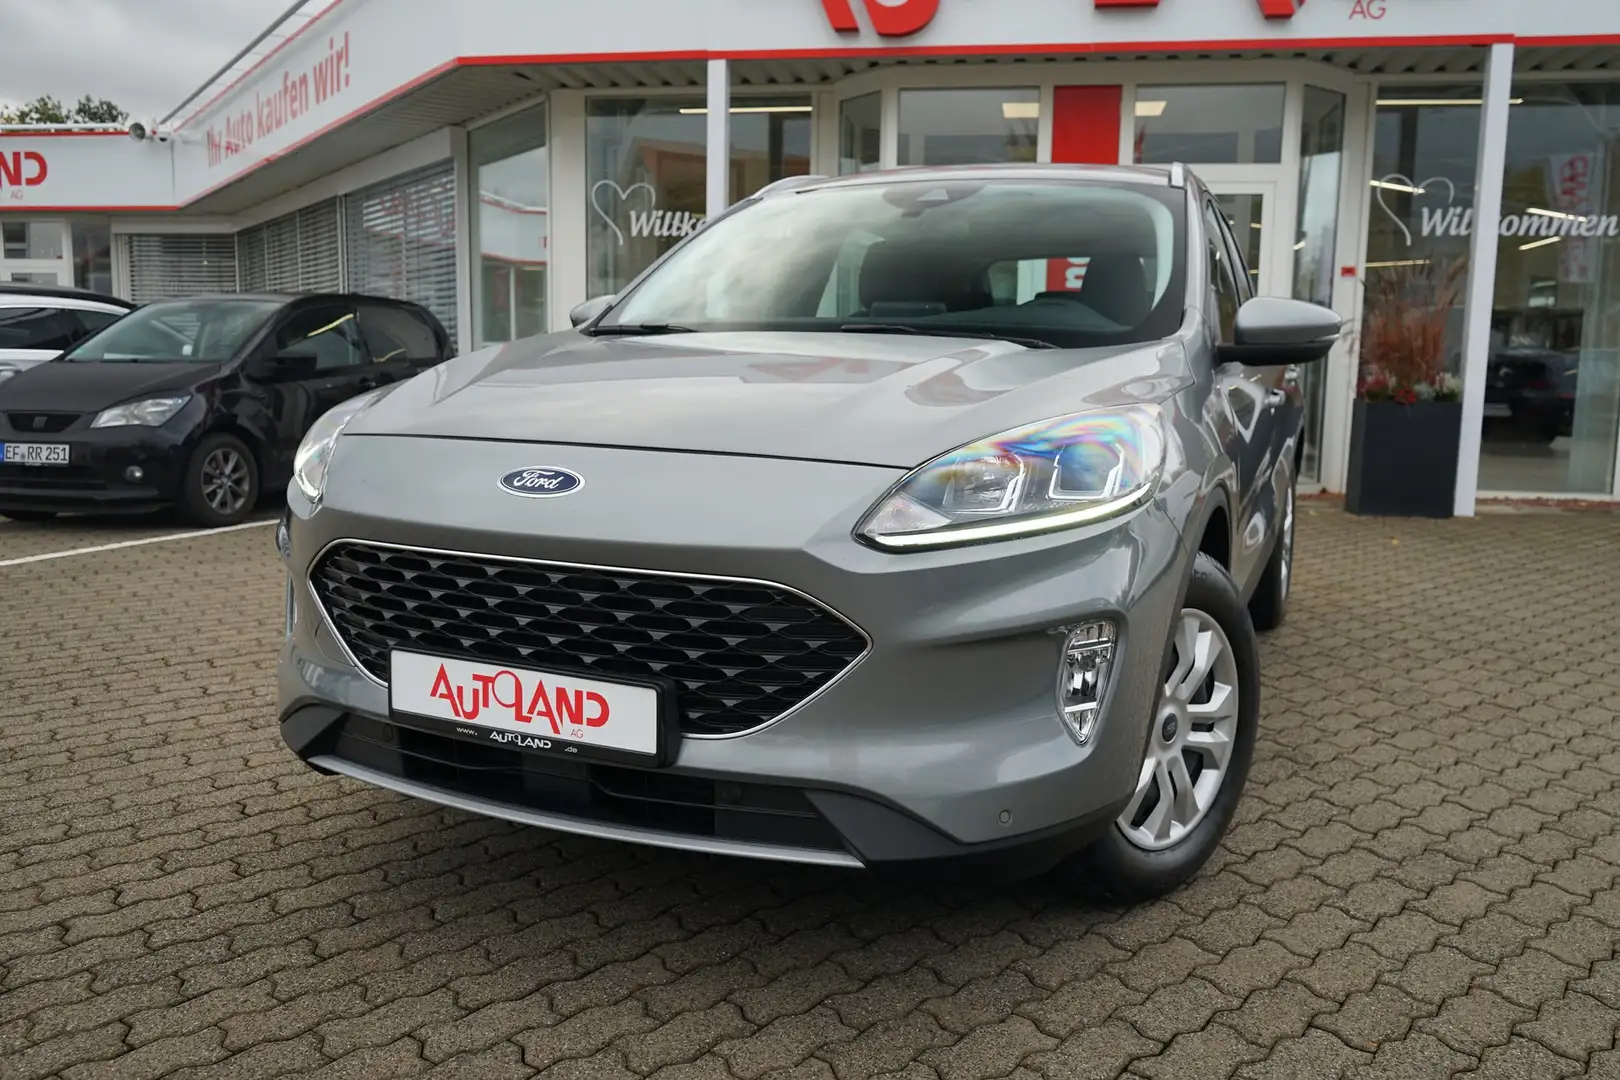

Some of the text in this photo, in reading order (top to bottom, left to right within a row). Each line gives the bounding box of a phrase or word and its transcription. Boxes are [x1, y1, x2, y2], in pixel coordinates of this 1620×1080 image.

[1348, 0, 1387, 20] AG
[206, 31, 350, 168] Ihr Auto kaufen wir!
[5, 445, 67, 461] EF RR 251
[513, 470, 564, 489] Ford
[430, 663, 610, 735] AUTOLAND
[456, 726, 578, 754] www. AUTOLAND .de
[570, 728, 584, 738] AG
